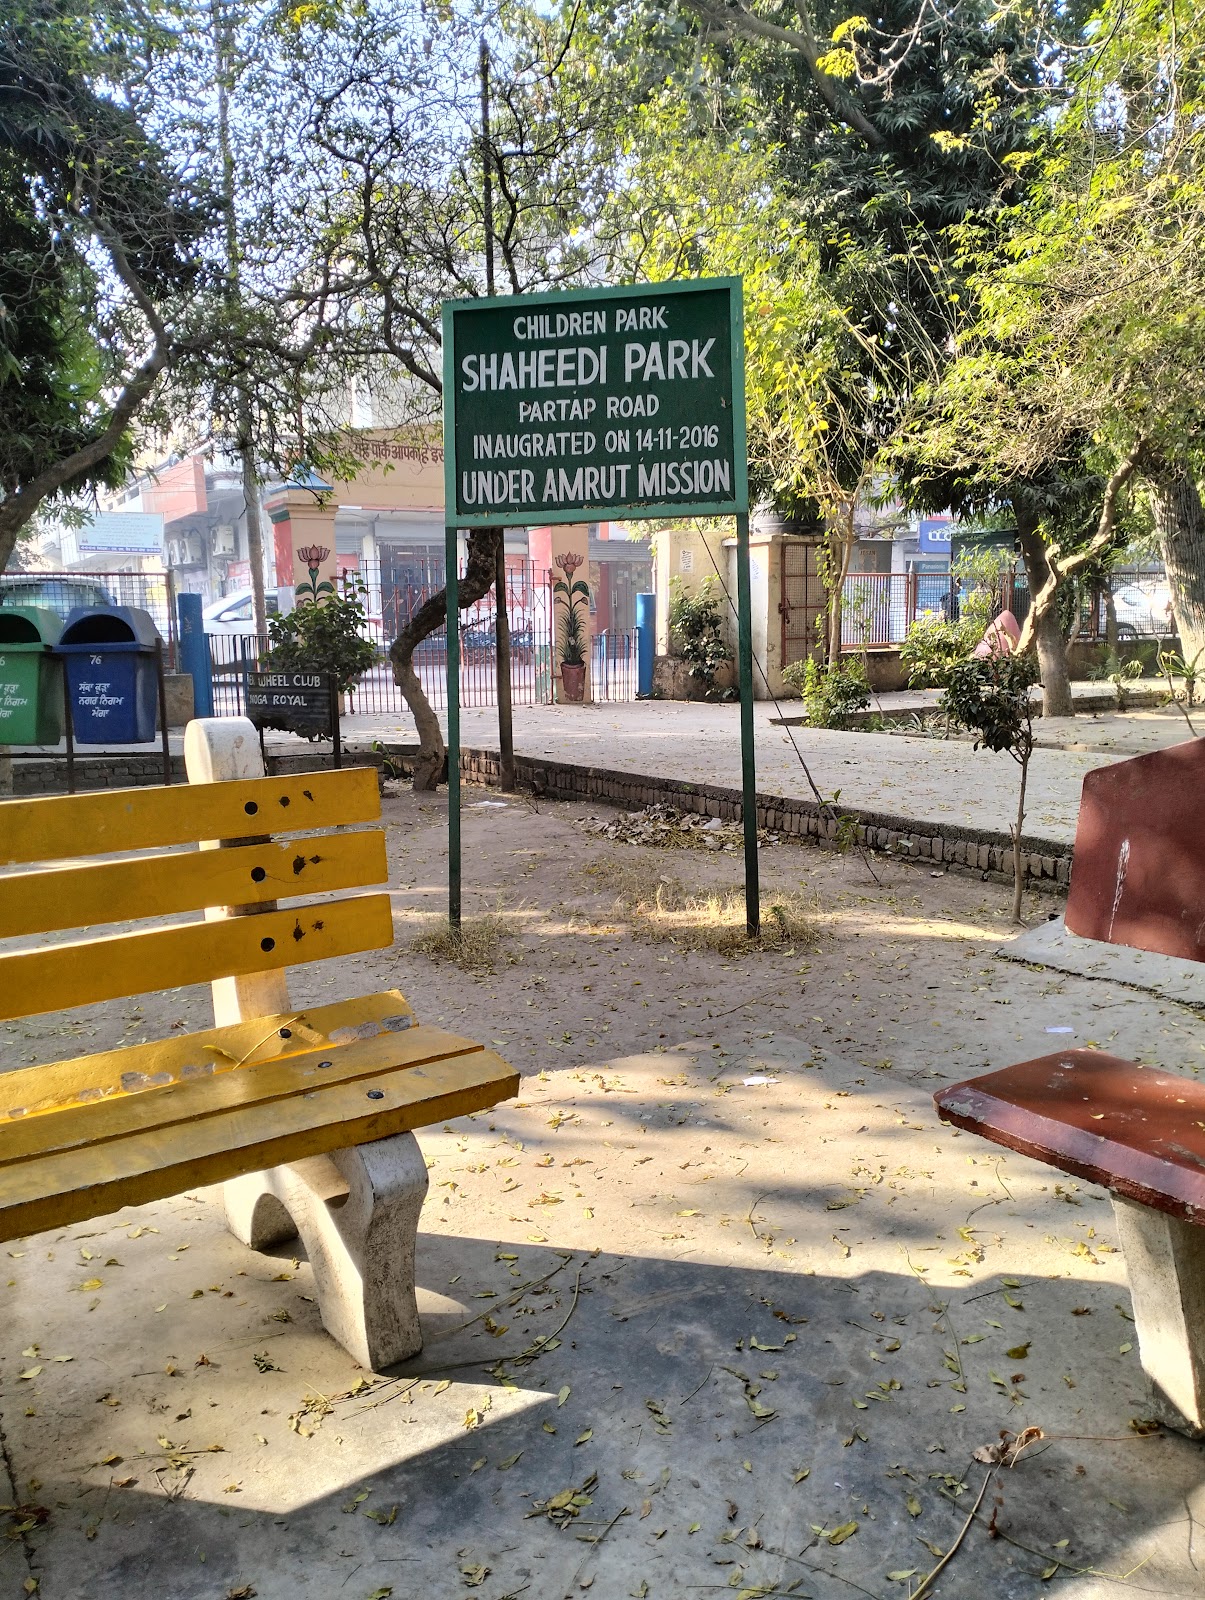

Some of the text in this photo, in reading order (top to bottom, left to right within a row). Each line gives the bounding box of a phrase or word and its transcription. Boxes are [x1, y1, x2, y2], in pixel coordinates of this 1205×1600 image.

[513, 306, 669, 339] CHILDREN PARK
[462, 338, 717, 392] SHAHEEDI PARK
[519, 394, 660, 423] PARTAP ROAD
[473, 424, 719, 459] INAUGRATED ON 14-11-2016
[462, 459, 731, 504] UNDER AMRUT MISSION
[89, 655, 102, 665] 76
[258, 674, 290, 687] WHEEL
[293, 674, 321, 687] CLUB
[272, 695, 308, 706] ROYAL
